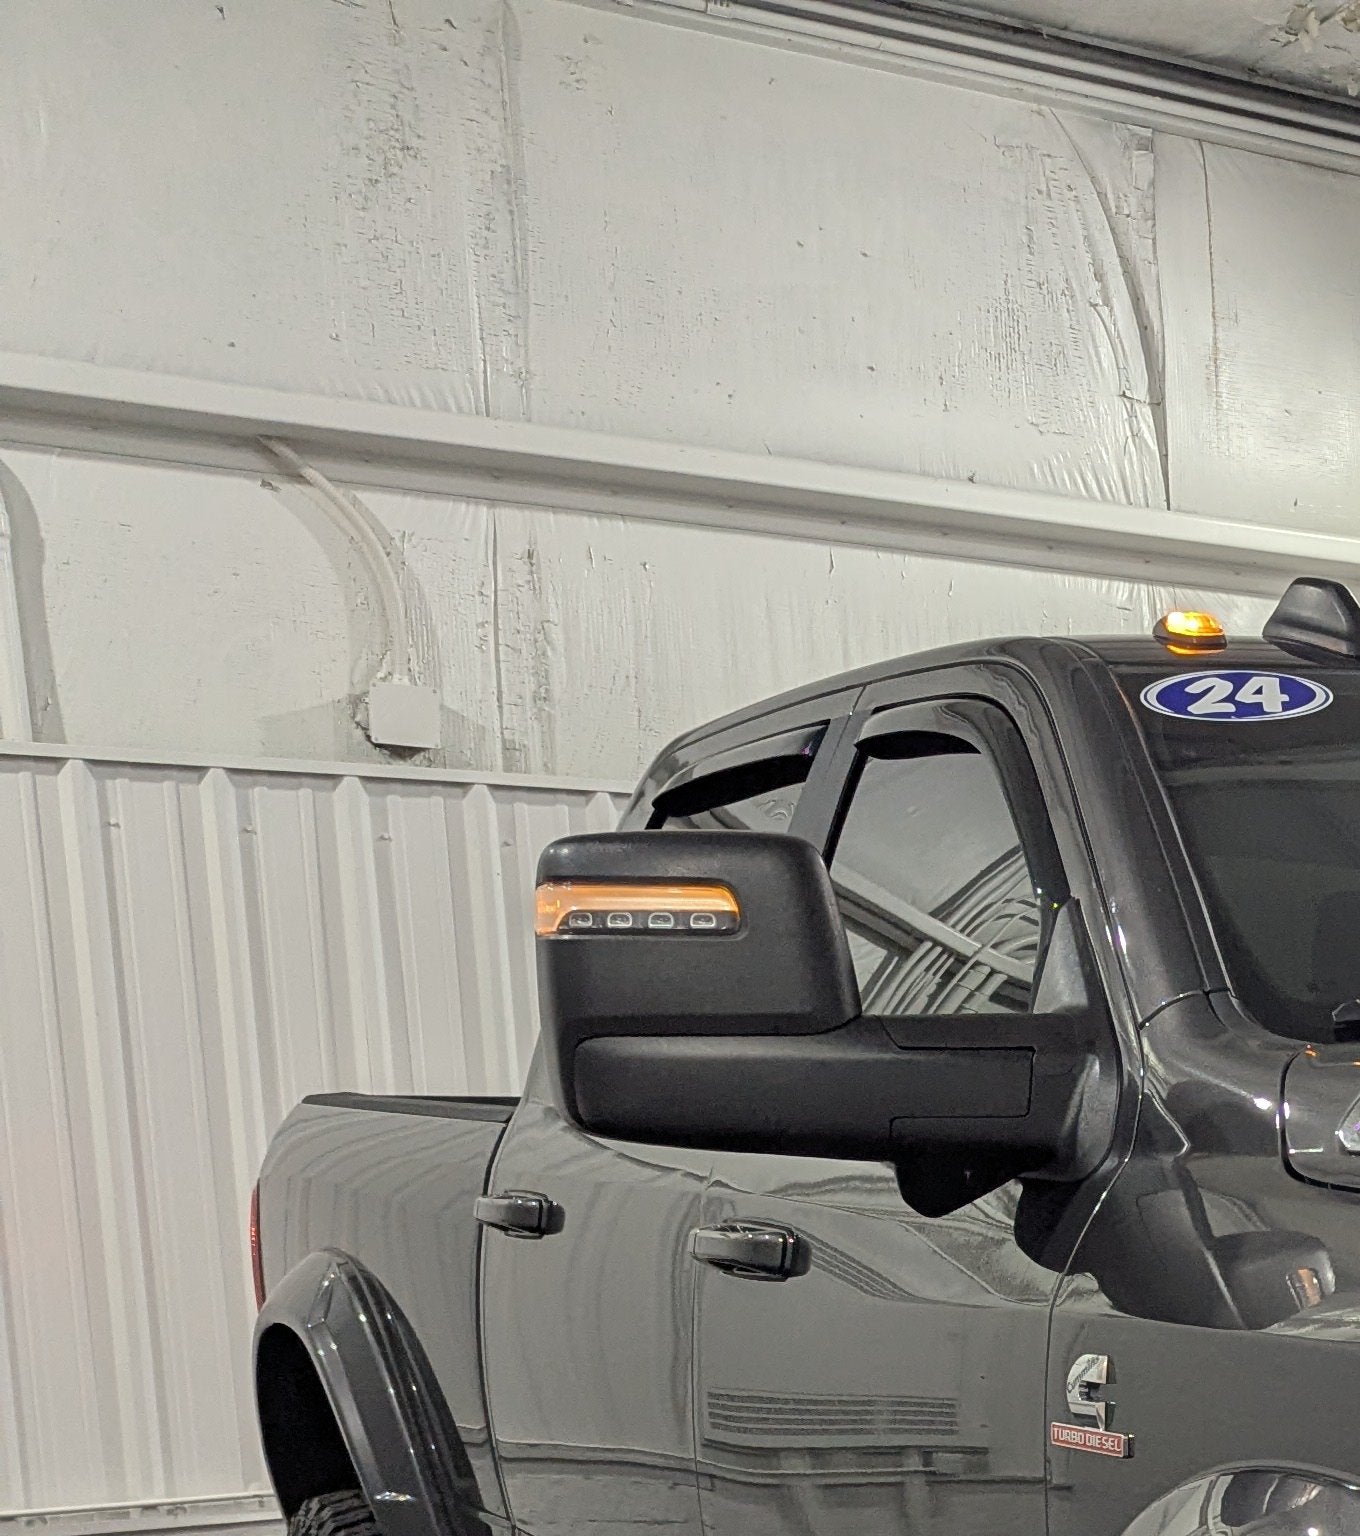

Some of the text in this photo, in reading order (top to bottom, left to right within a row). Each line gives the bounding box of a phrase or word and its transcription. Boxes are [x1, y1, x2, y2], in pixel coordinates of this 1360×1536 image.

[1184, 676, 1290, 715] 24
[1053, 1427, 1122, 1451] TURBO DIESEL
